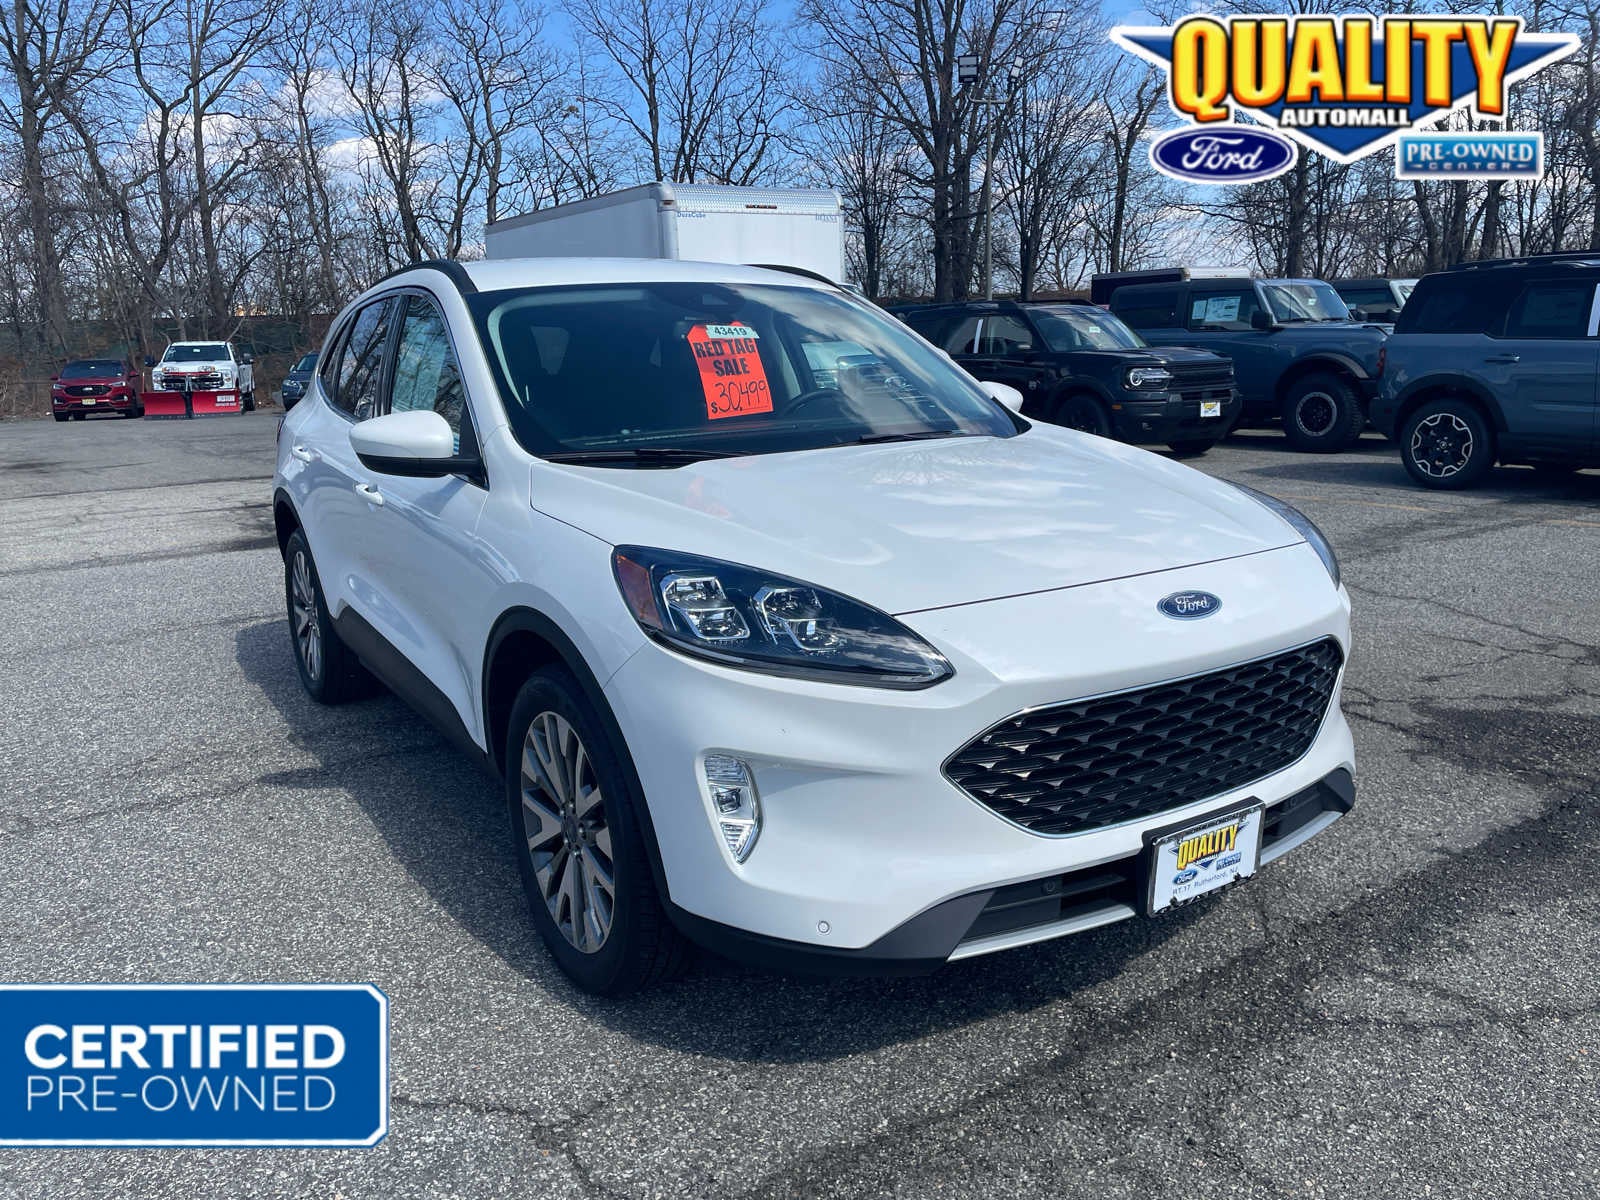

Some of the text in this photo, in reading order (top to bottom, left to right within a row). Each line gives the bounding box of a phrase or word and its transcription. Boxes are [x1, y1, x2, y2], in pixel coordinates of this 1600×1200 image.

[714, 326, 748, 336] 43419
[692, 338, 756, 358] RED TAG
[713, 358, 750, 377] SALE
[1175, 595, 1210, 613] Ford
[1177, 823, 1239, 871] QUALITY
